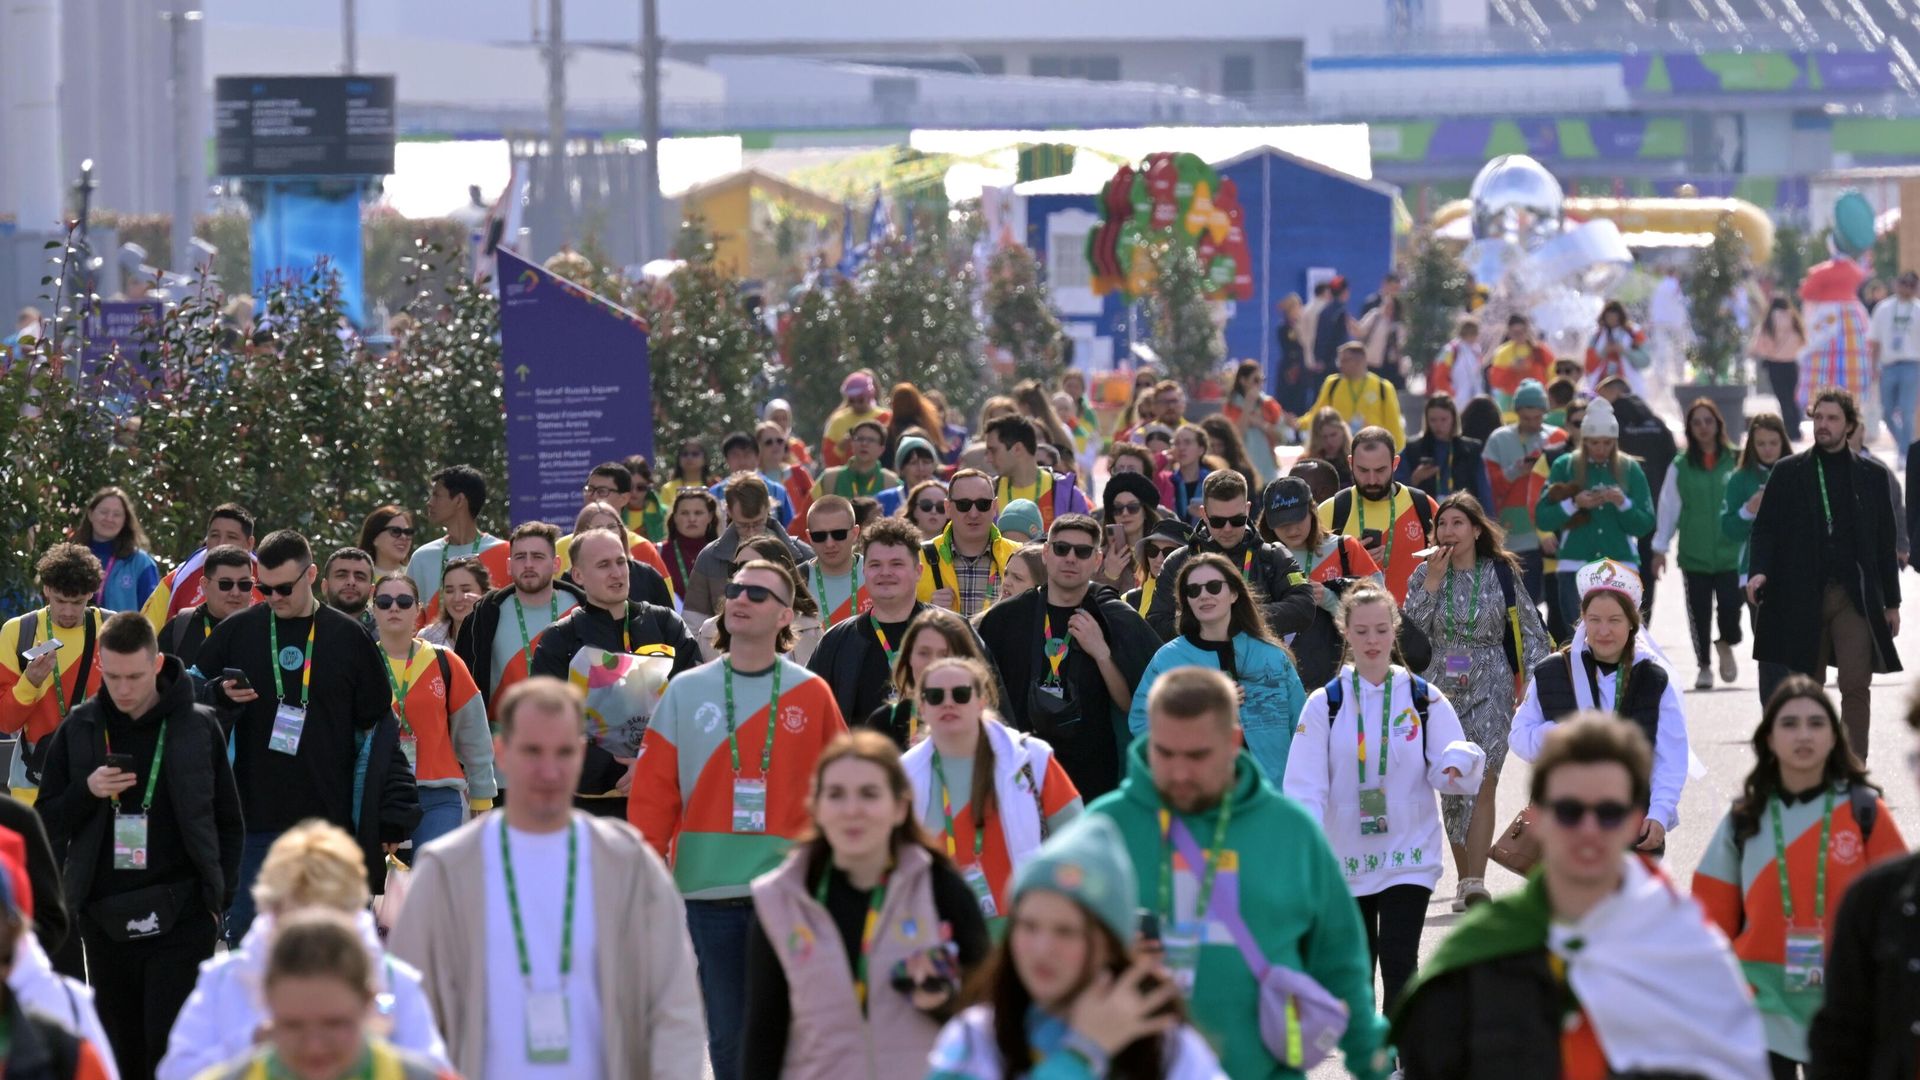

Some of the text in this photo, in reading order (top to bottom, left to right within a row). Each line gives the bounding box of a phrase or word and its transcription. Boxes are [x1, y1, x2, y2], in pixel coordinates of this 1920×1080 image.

[564, 386, 590, 395] Russia
[591, 385, 620, 395] Square
[537, 411, 560, 420] World
[561, 410, 603, 419] Friendship
[537, 420, 589, 429] Games Arena
[538, 451, 562, 459] World
[563, 449, 591, 458] Market
